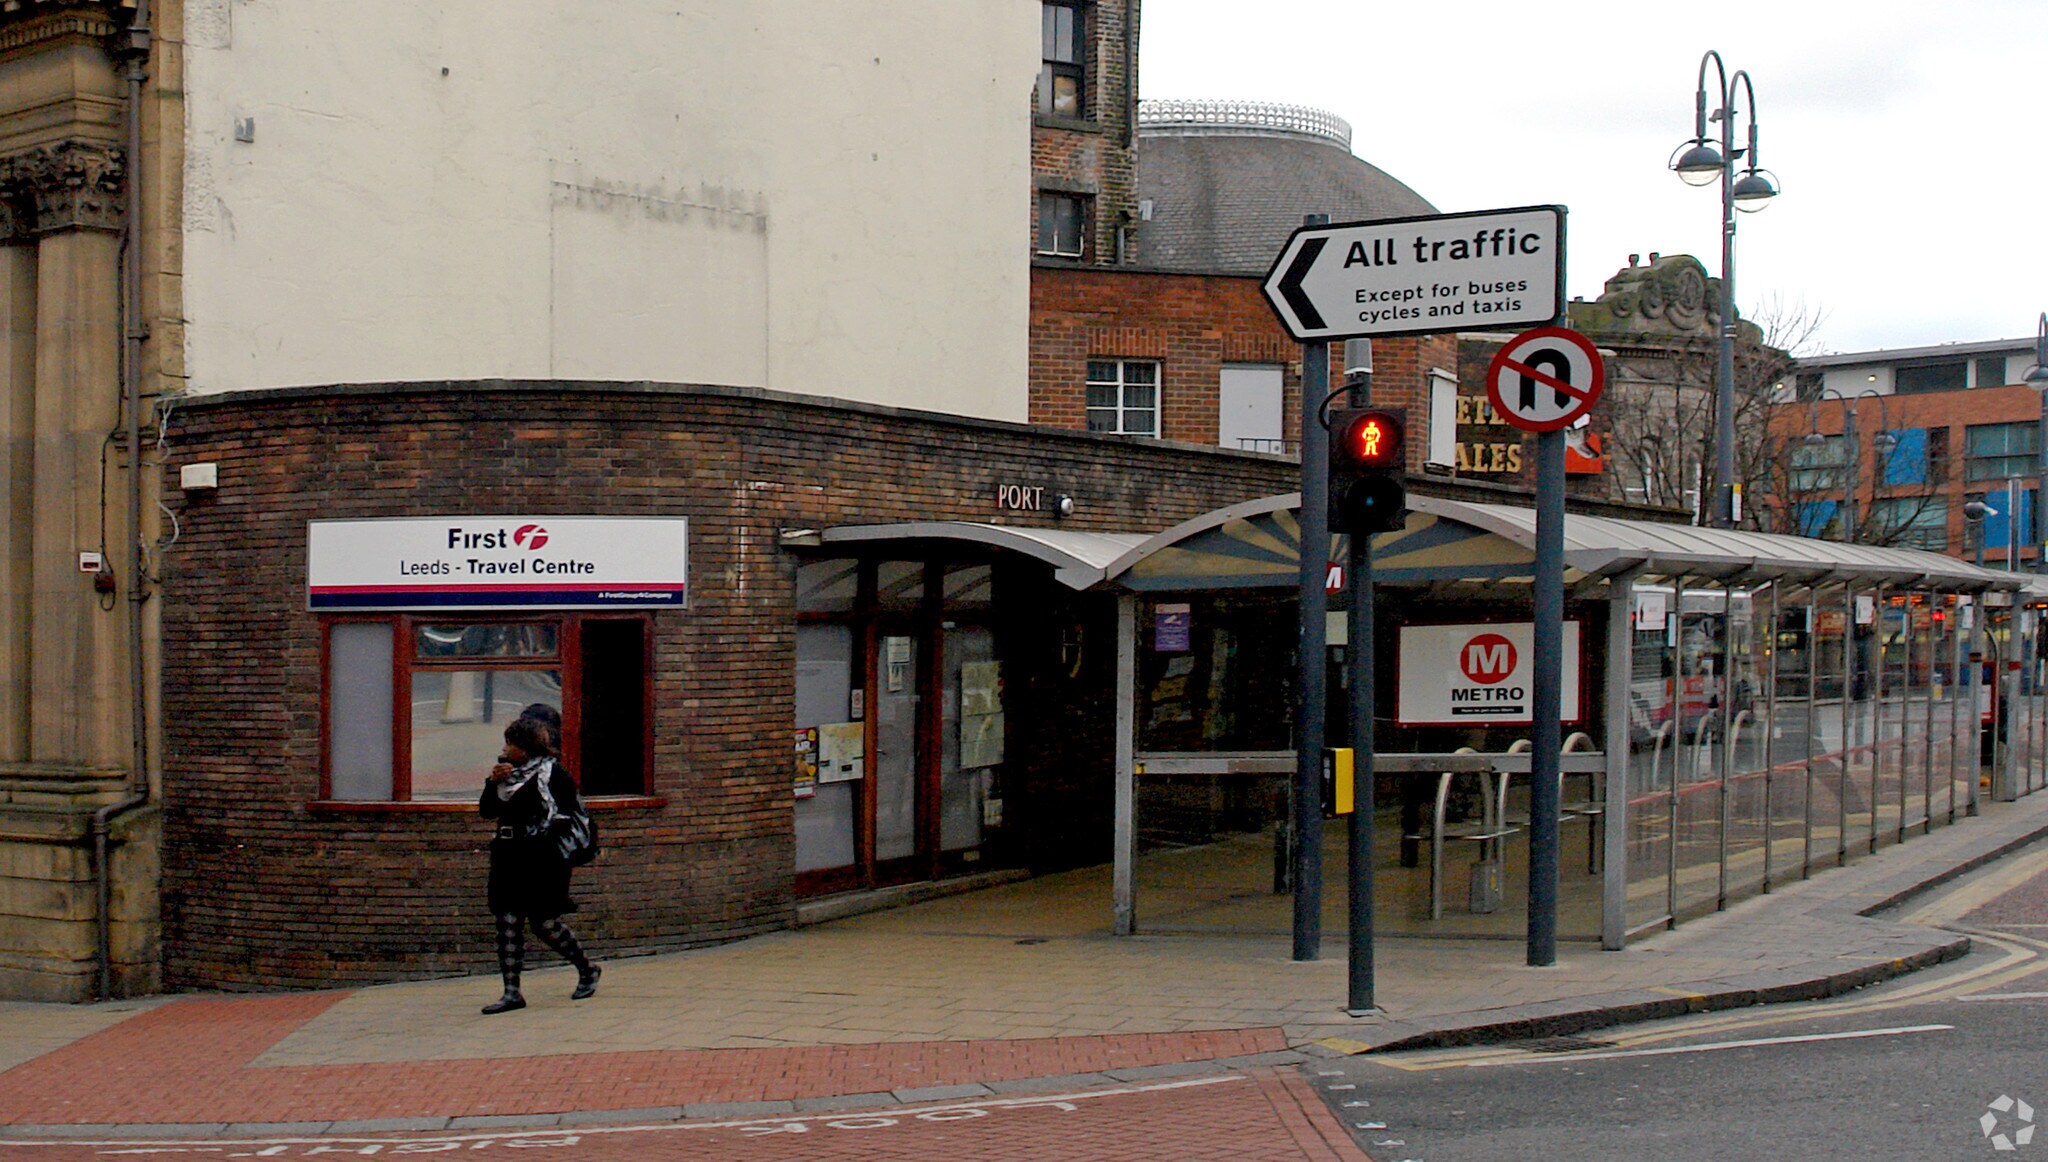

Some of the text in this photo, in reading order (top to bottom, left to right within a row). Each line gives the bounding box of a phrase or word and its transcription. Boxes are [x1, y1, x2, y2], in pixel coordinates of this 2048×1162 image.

[1343, 228, 1541, 269] All traffic
[1355, 280, 1528, 304] Except for buses
[1358, 297, 1522, 325] cycles and taxis
[1456, 442, 1522, 473] ALES
[998, 484, 1044, 511] PORT
[448, 527, 507, 549] First
[400, 559, 450, 575] Leeds
[466, 558, 526, 574] Travel
[531, 558, 595, 574] Centre
[1468, 644, 1509, 674] M
[1451, 686, 1525, 702] METRO
[740, 1101, 1077, 1137] LOOK
